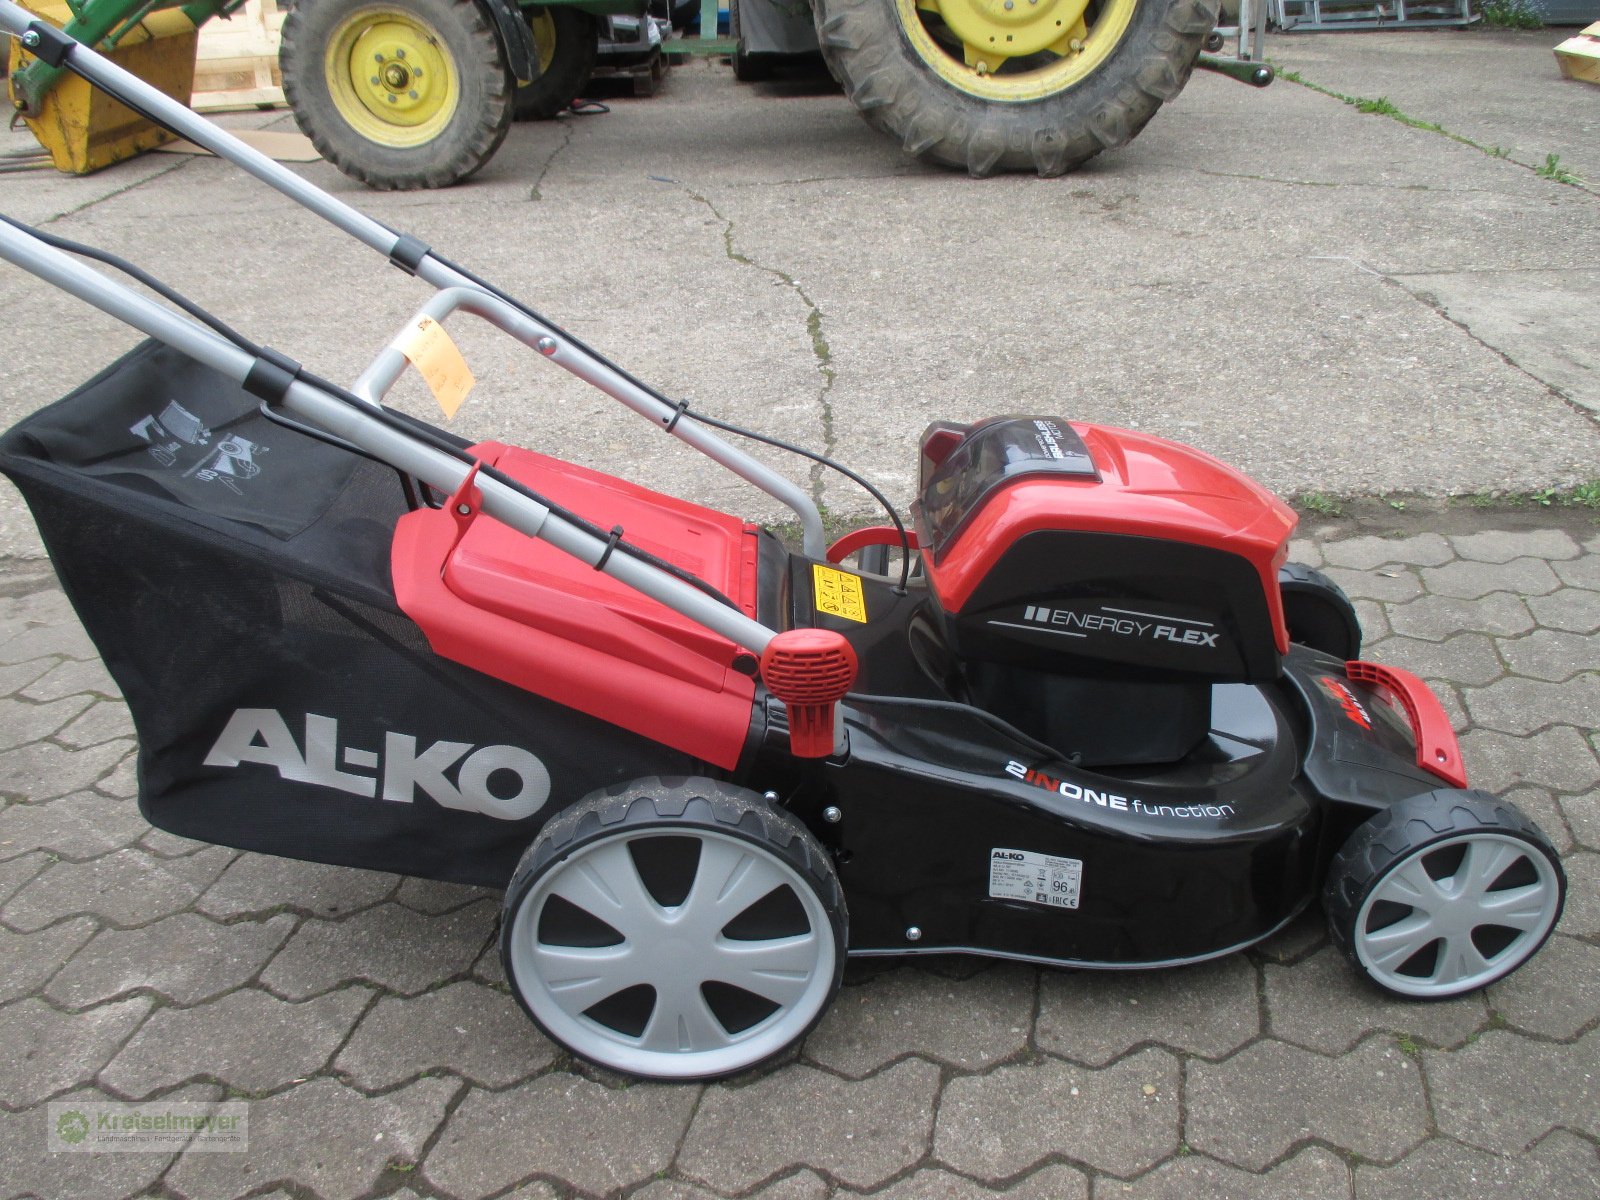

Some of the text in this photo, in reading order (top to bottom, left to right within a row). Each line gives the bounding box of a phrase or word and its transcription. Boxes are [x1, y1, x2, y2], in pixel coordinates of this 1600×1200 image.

[1033, 420, 1065, 459] BRUSHLESS
[1051, 609, 1221, 648] ENERGY FLEX
[202, 708, 551, 821] AL-KO
[1131, 799, 1236, 818] function
[992, 851, 1025, 861] AL-KO
[1053, 880, 1068, 892] 96
